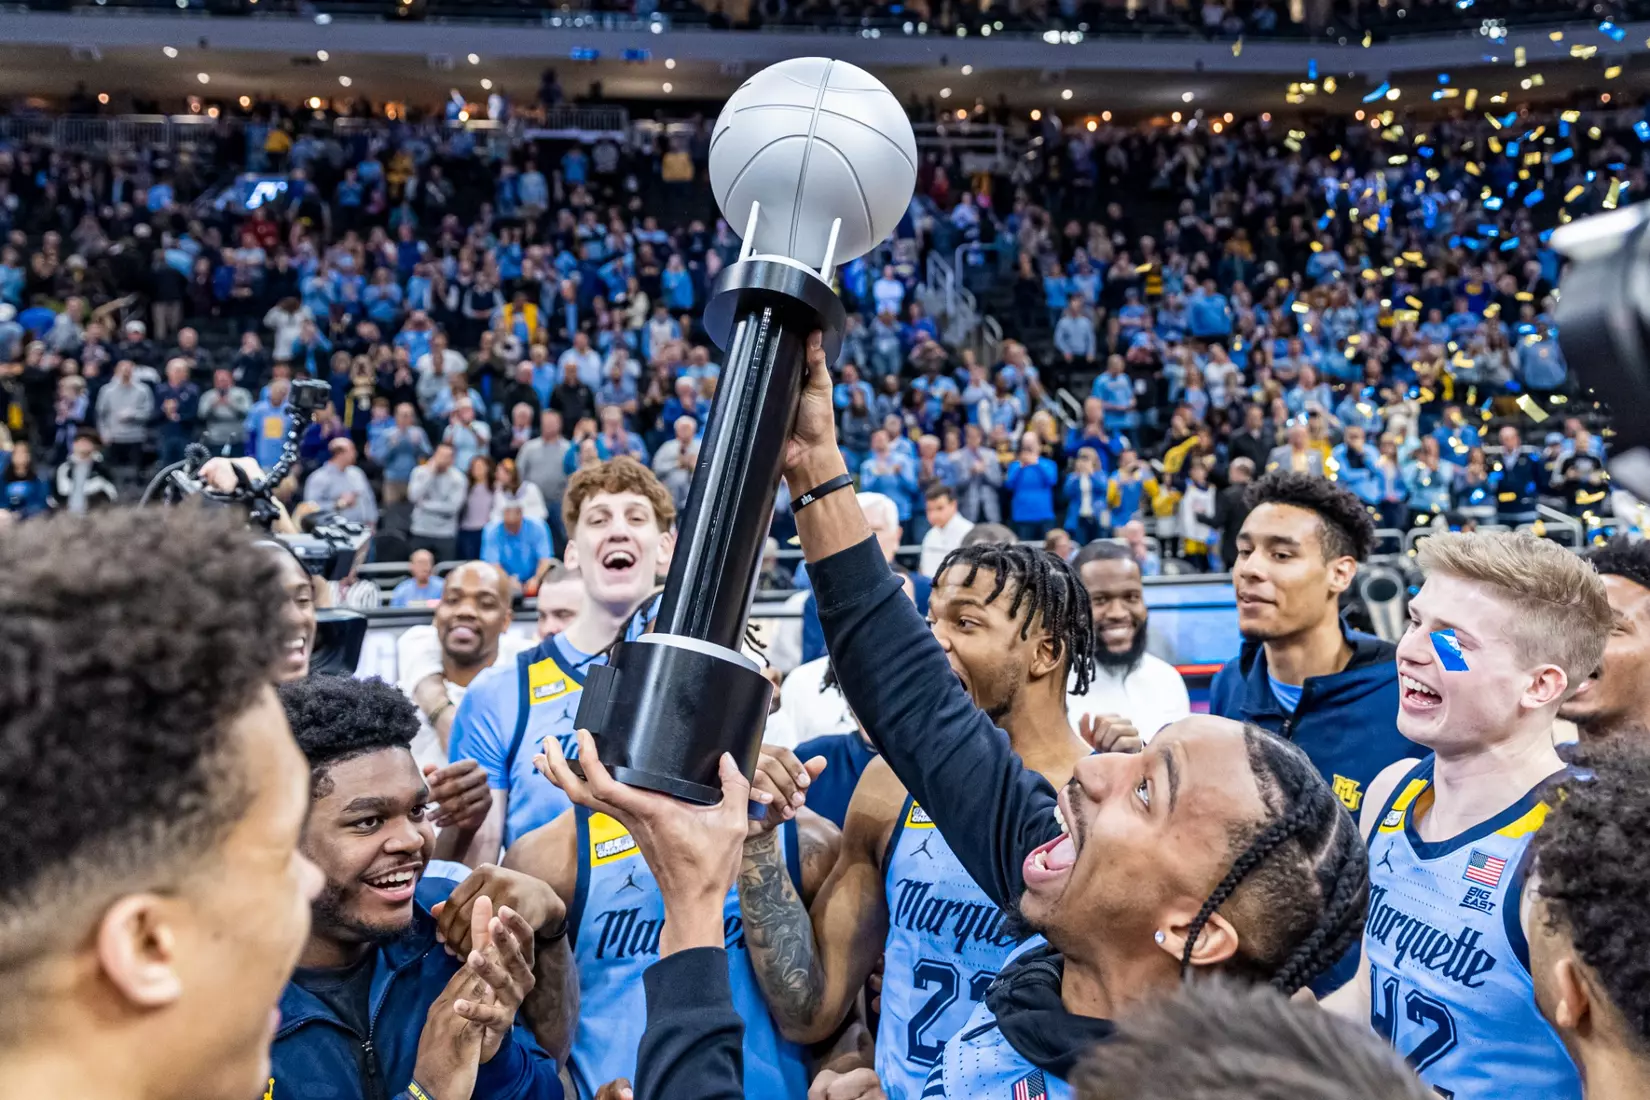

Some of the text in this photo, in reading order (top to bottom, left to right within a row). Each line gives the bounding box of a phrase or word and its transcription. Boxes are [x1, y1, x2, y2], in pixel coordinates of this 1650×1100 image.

[1332, 773, 1363, 812] MU
[1462, 894, 1497, 911] EAST
[1466, 886, 1492, 900] BIG
[906, 957, 998, 1068] 2
